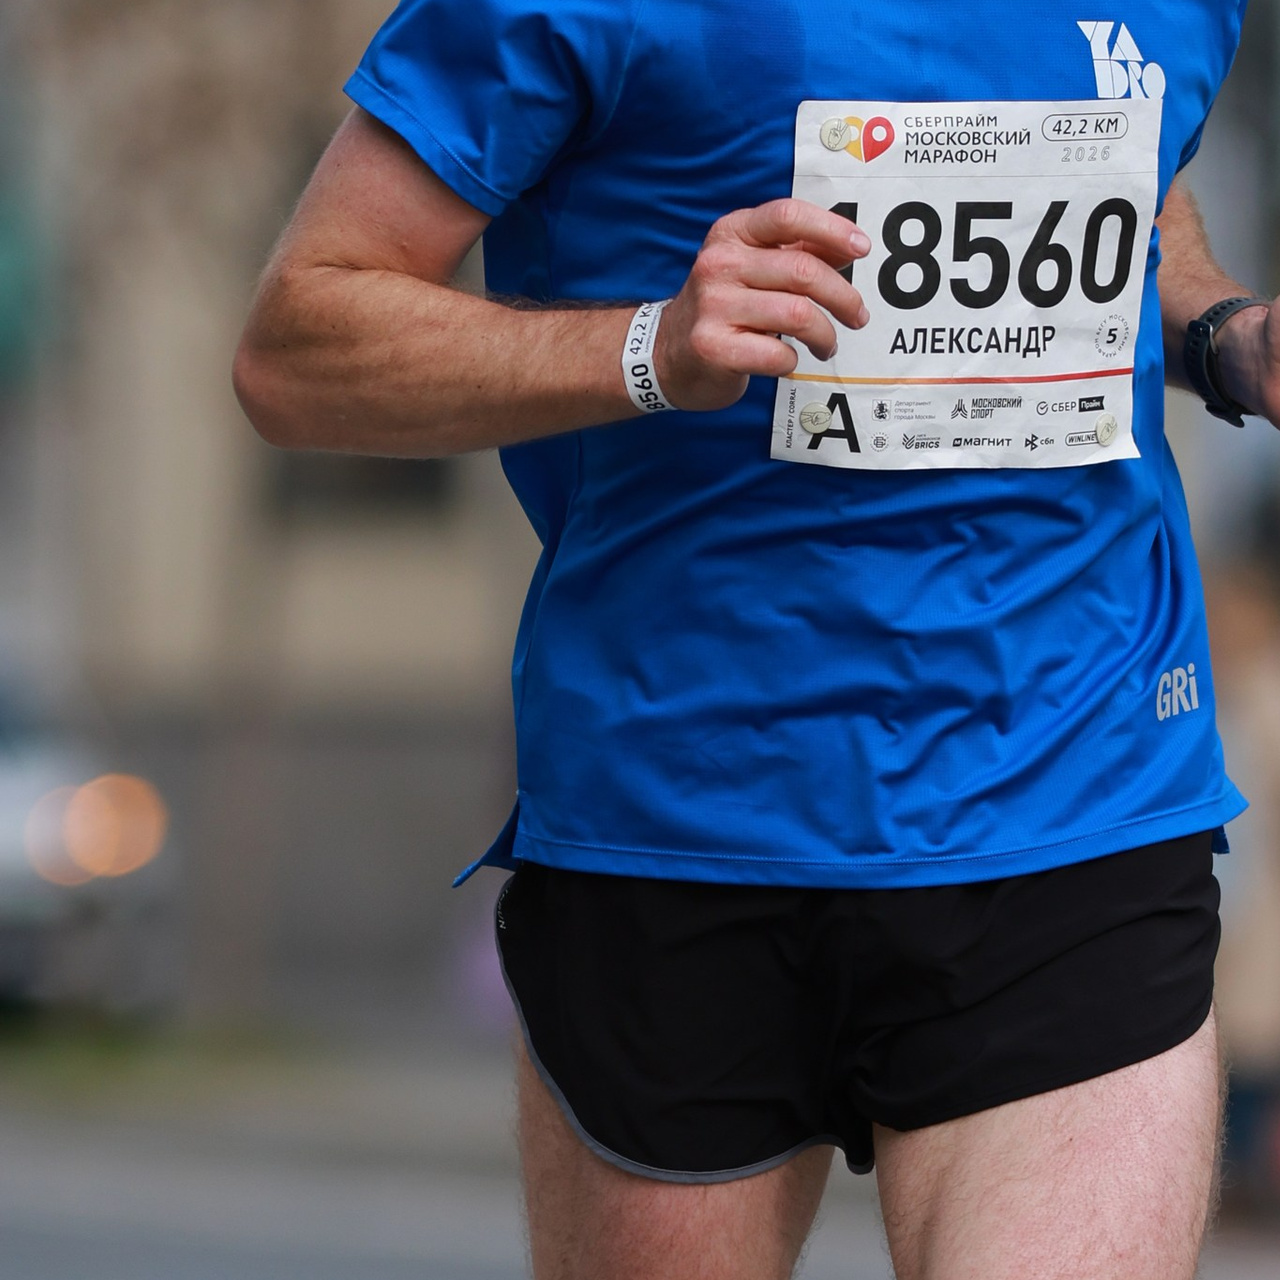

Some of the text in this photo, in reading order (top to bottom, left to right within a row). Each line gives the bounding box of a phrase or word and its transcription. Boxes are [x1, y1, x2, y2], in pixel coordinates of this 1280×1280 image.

[904, 114, 998, 127] СБЕРПРАЙМ
[1052, 118, 1119, 137] 42,2 КМ
[905, 128, 1031, 146] МОСКОВСКИЙ
[904, 148, 997, 164] МАРАФОН
[1061, 146, 1111, 163] 2026
[630, 323, 647, 355] 42,2
[889, 325, 1056, 359] АЛЕКСАНДР
[1106, 327, 1118, 344] 5
[788, 387, 797, 414] CORRAL
[971, 396, 1023, 409] МОСКОВСКИЙ
[1051, 401, 1077, 413] СБЕР
[970, 408, 994, 419] СПОРТ
[786, 418, 794, 449] КЛАСТЕР
[1040, 437, 1055, 446] сбп
[1068, 433, 1096, 444] WINLINE
[914, 441, 940, 449] BRICS
[963, 437, 1012, 447] магнит
